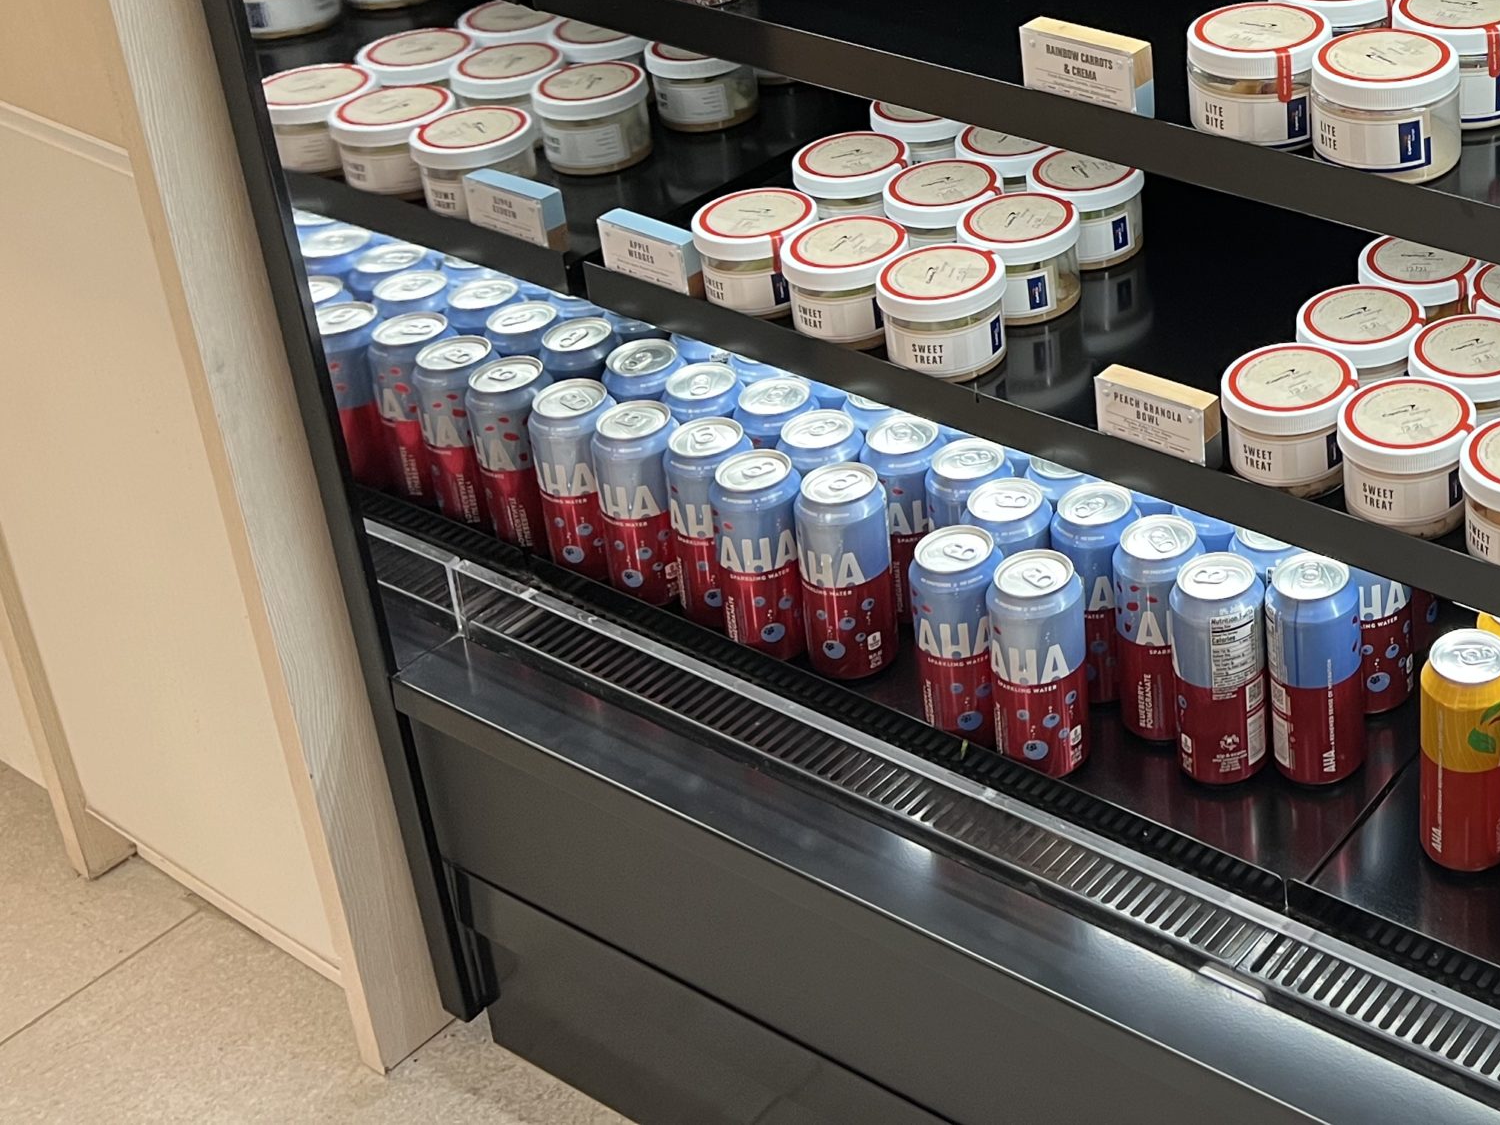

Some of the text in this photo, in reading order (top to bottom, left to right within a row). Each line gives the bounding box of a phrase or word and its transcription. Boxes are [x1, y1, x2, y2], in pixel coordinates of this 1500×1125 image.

[1046, 44, 1113, 71] RAINBOW CARROTS
[1064, 63, 1097, 81] & CREMA
[1205, 101, 1224, 117] LITE
[1206, 114, 1225, 131] BITE
[1320, 119, 1336, 137] LITE
[1321, 133, 1338, 151] BITE
[630, 240, 650, 254] APPLE
[628, 249, 654, 264] WEDGES
[798, 304, 822, 319] SWEET
[800, 315, 823, 329] TREAT
[911, 343, 944, 355] SWEET
[914, 355, 944, 365] TREAT
[1114, 392, 1182, 423] PEACH GRANOLA
[1136, 411, 1160, 427] BOWL
[1243, 444, 1272, 461] SWEET
[1244, 456, 1272, 472] TREAT
[1362, 482, 1395, 500] SWEET
[1364, 495, 1394, 511] TREAT
[1468, 519, 1490, 545] SWEET
[720, 529, 798, 573] AHA
[1468, 532, 1490, 556] TREAT
[768, 568, 790, 581] WATER
[1359, 581, 1406, 621] HA
[1378, 616, 1398, 627] WATER
[918, 616, 990, 659] AHA
[991, 639, 1070, 685] AHA
[1032, 684, 1057, 693] WATER
[1323, 750, 1336, 773] AHA
[1431, 827, 1442, 853] AHA
